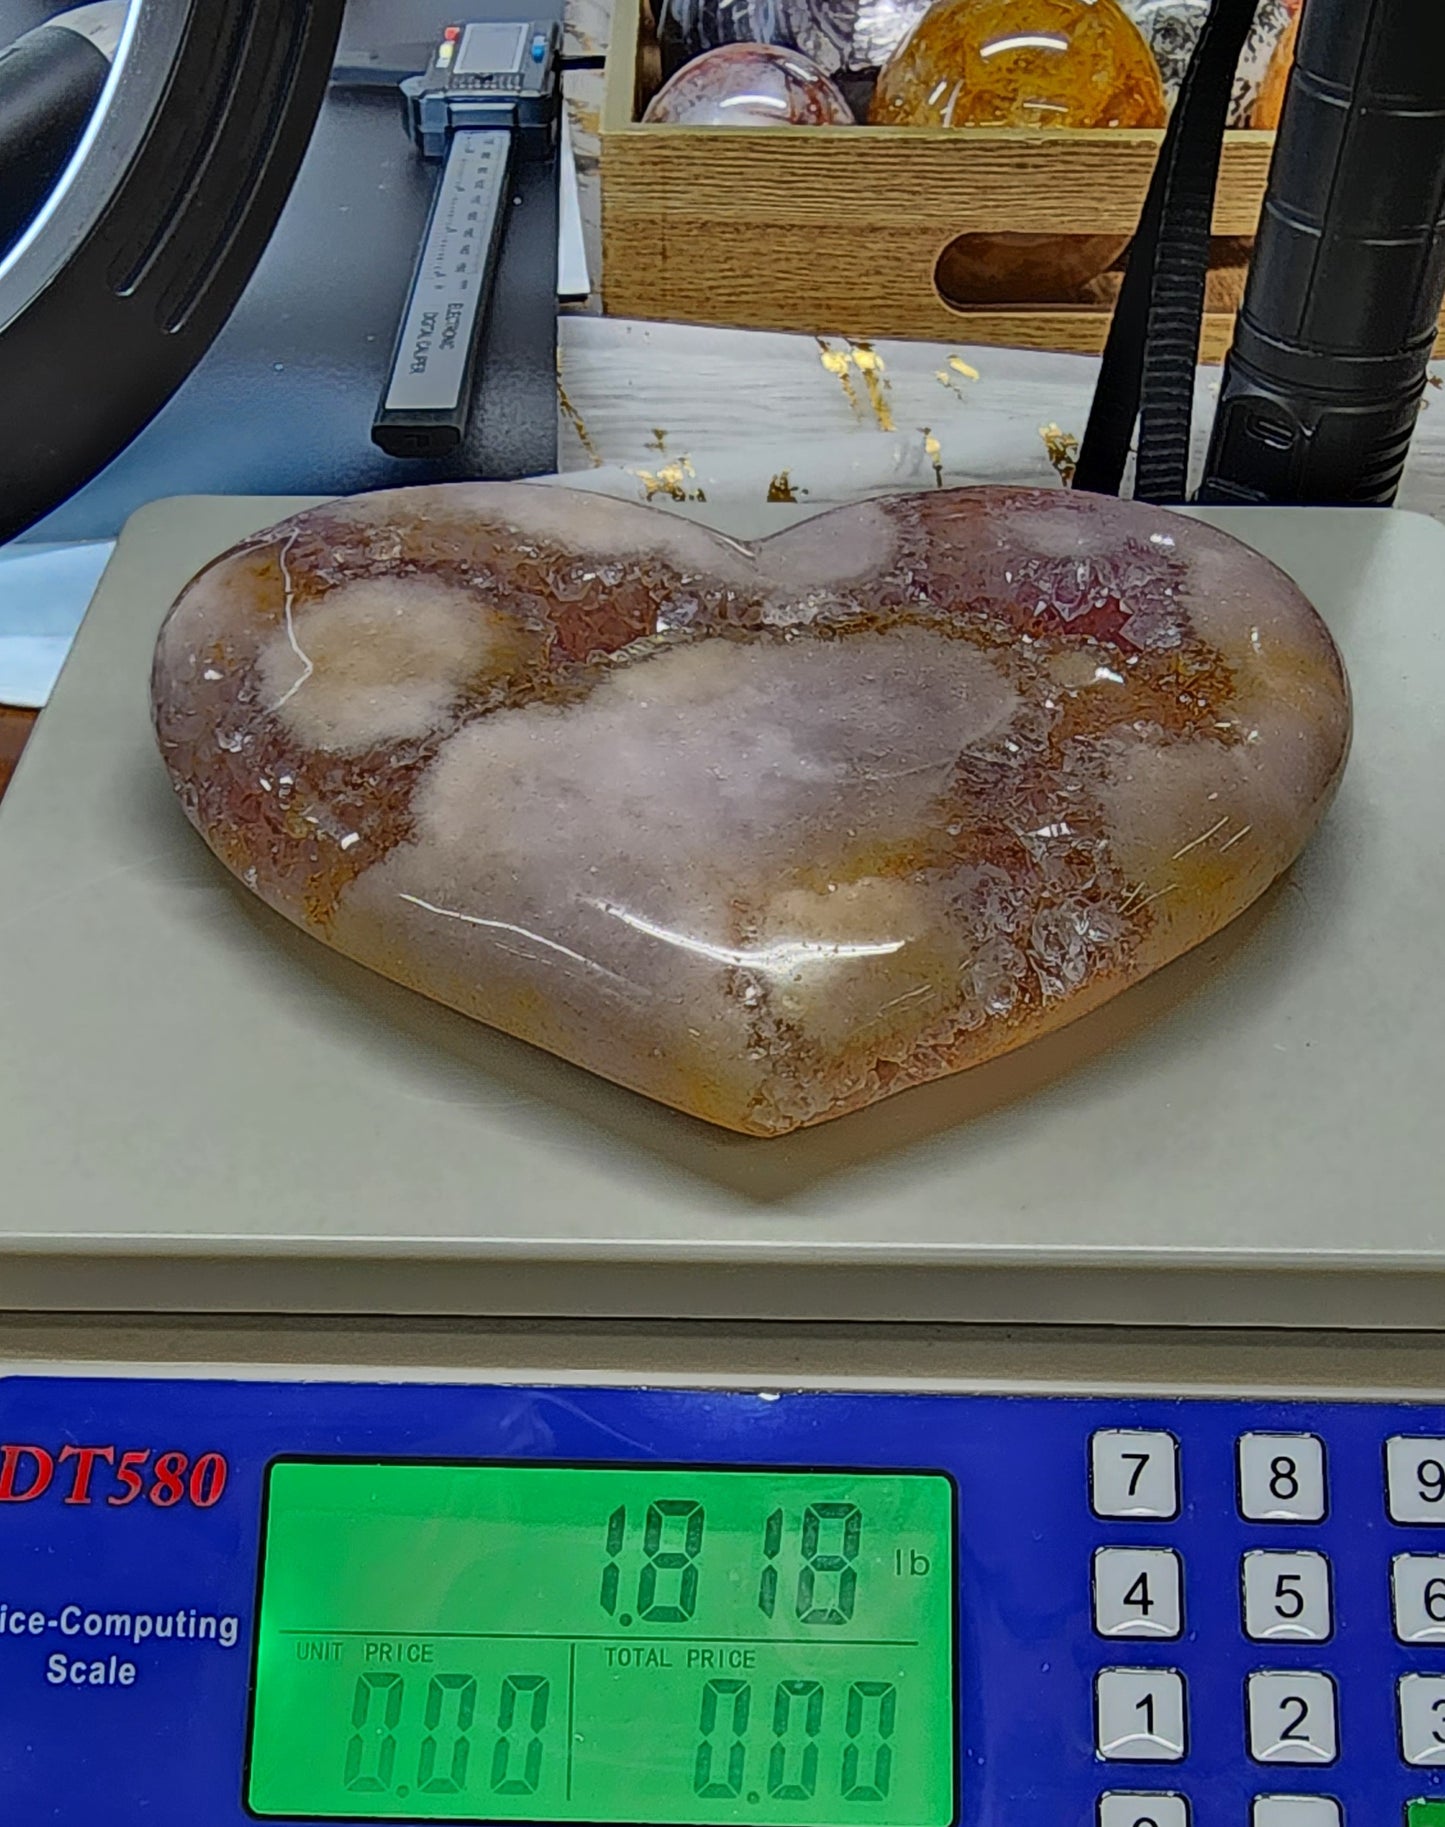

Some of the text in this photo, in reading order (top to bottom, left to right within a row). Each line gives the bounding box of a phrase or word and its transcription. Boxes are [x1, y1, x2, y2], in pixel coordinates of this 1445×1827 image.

[0, 1445, 228, 1507] DT580
[1121, 1453, 1150, 1496] 7
[1269, 1456, 1299, 1500] 8
[1417, 1459, 1445, 1502] 9
[600, 1500, 930, 1626] 1.818 lb
[1122, 1572, 1154, 1615] 4
[1274, 1574, 1304, 1618] 5
[1424, 1578, 1445, 1622] 6
[47, 1654, 136, 1685] Scale
[297, 1642, 434, 1663] UNIT PRICE
[605, 1648, 756, 1669] TOTAL PRICE
[344, 1672, 550, 1799] 0.00
[1135, 1693, 1154, 1736] 1
[1279, 1696, 1310, 1741] 2
[694, 1678, 897, 1805] 0.00
